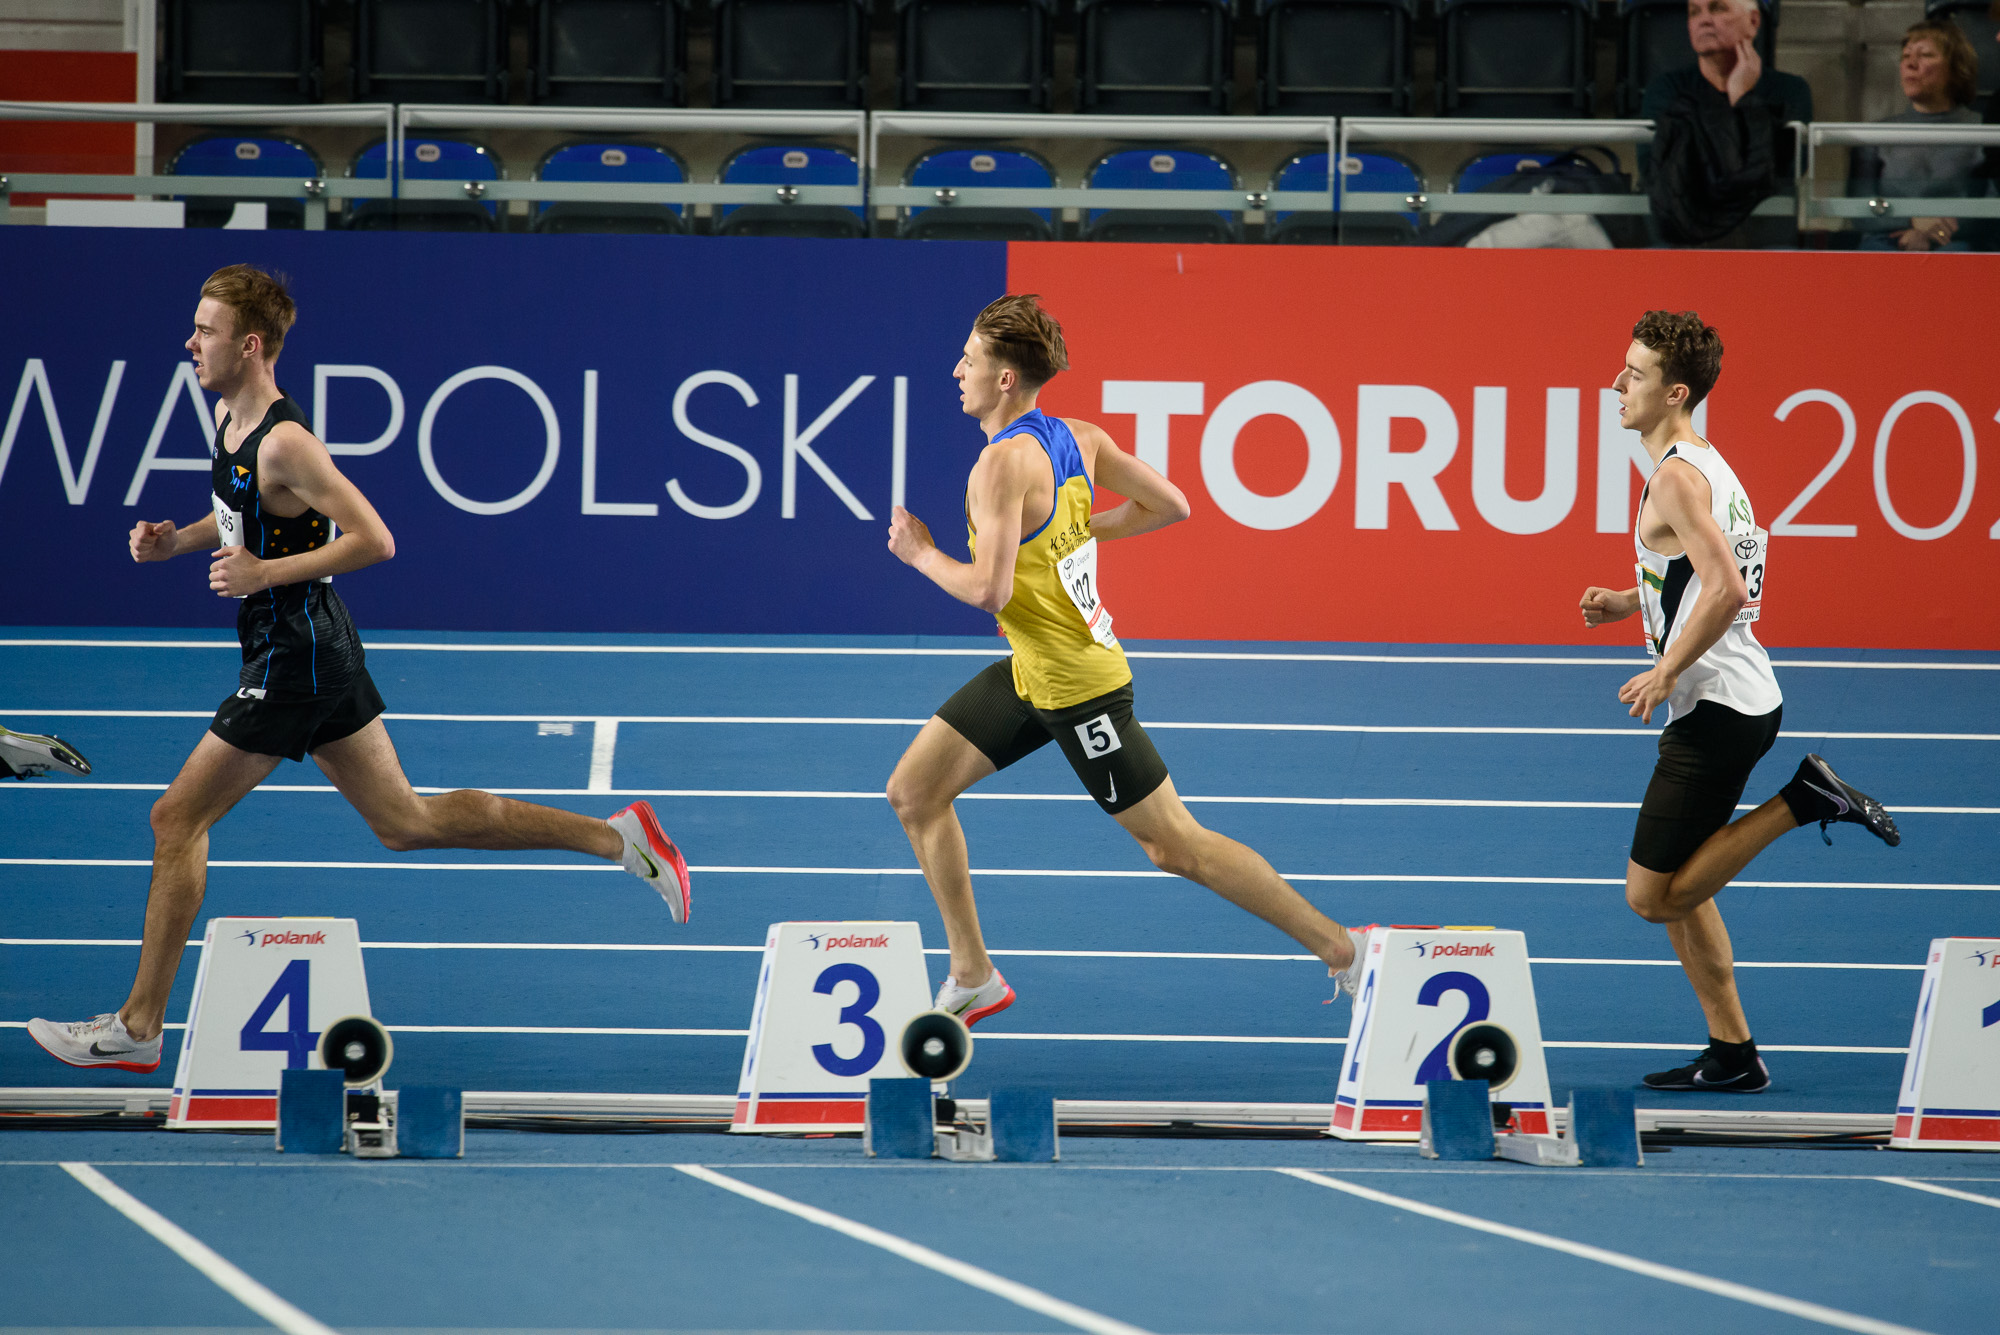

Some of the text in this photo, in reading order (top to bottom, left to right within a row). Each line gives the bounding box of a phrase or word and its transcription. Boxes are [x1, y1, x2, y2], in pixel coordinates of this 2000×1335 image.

[313, 364, 908, 521] POLSKI
[1769, 388, 2000, 541] 20
[220, 509, 234, 533] 365
[1086, 719, 1111, 753] 5
[261, 930, 329, 948] polanik
[825, 933, 891, 952] polanik
[1431, 943, 1496, 960] polanik
[239, 959, 322, 1070] 4
[811, 962, 886, 1078] 3
[1414, 971, 1491, 1086] 2
